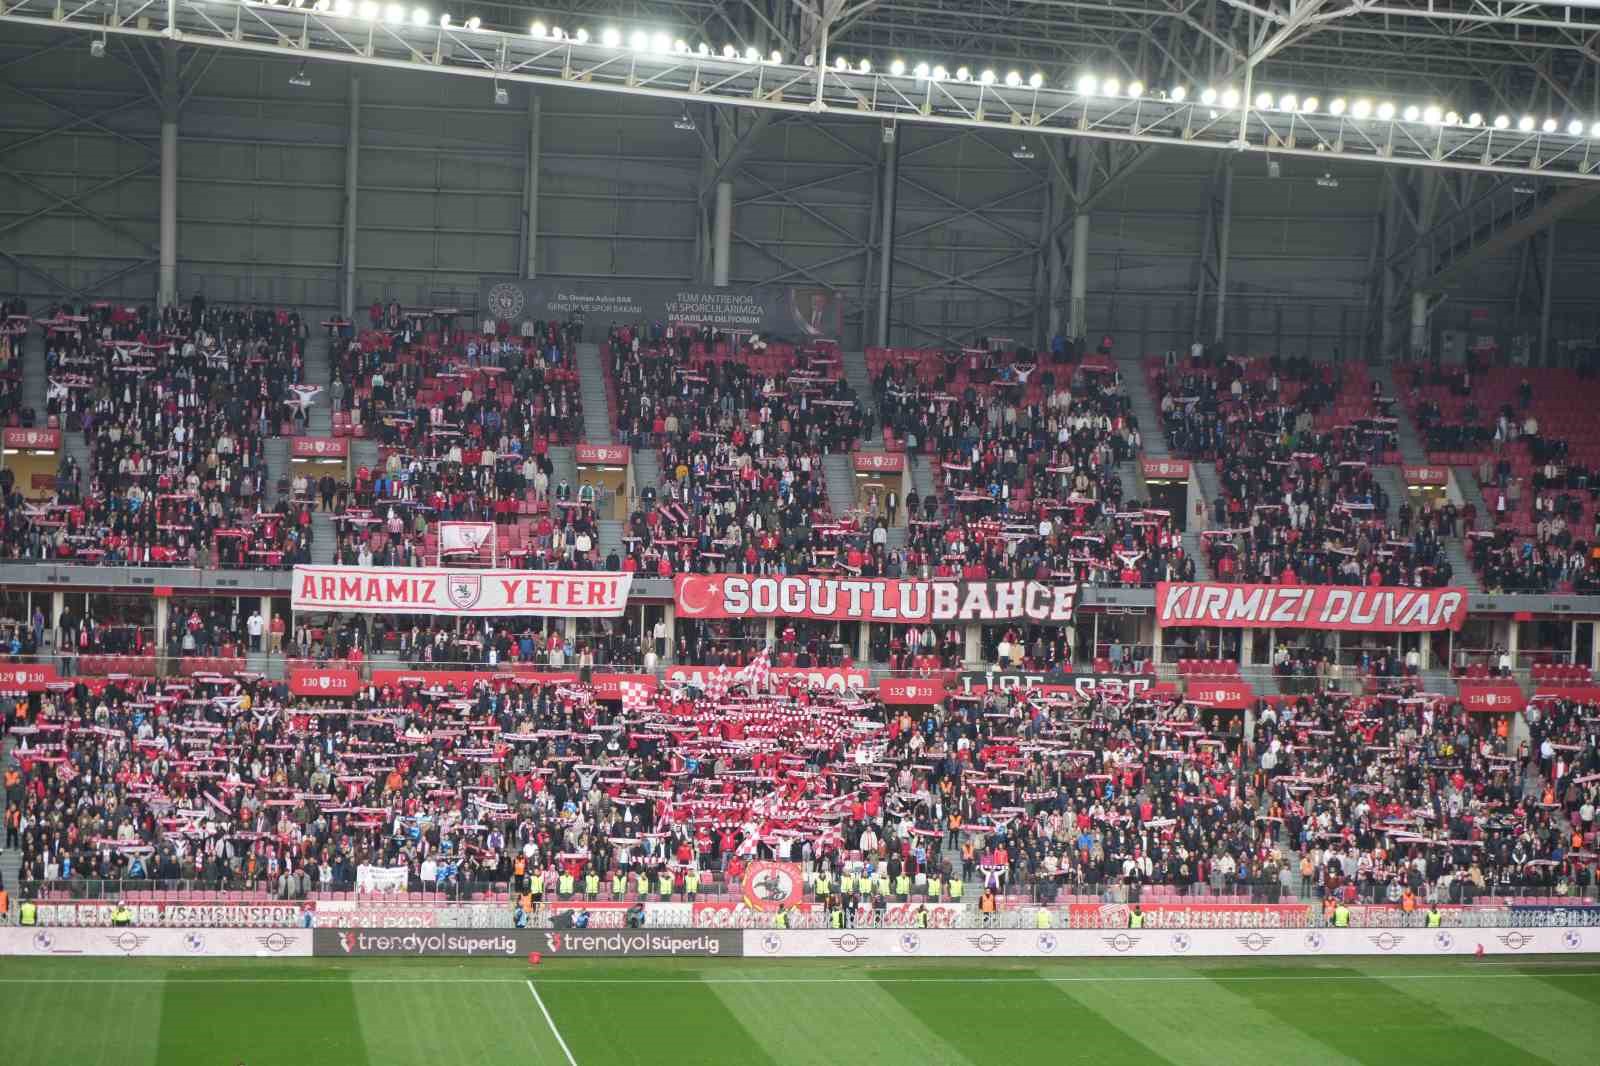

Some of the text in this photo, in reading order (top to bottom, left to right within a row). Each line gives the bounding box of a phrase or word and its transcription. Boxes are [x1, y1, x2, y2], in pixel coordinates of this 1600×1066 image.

[9, 432, 25, 443] 233
[38, 432, 53, 443] 234
[297, 442, 312, 452] 234
[883, 457, 898, 468] 237
[300, 574, 617, 606] ARMAMIZ YETER!
[1162, 585, 1462, 627] KIRMIZI DUVAR
[28, 671, 44, 682] 130
[301, 677, 317, 688] 130
[330, 678, 346, 688] 131
[603, 682, 617, 692] 131
[888, 687, 904, 697] 132
[916, 687, 932, 697] 133
[1199, 691, 1214, 701] 133
[1226, 691, 1242, 701] 134
[1470, 695, 1485, 705] 134
[1497, 696, 1512, 706] 135
[357, 932, 446, 954] trendyol
[563, 932, 650, 954] trendyol
